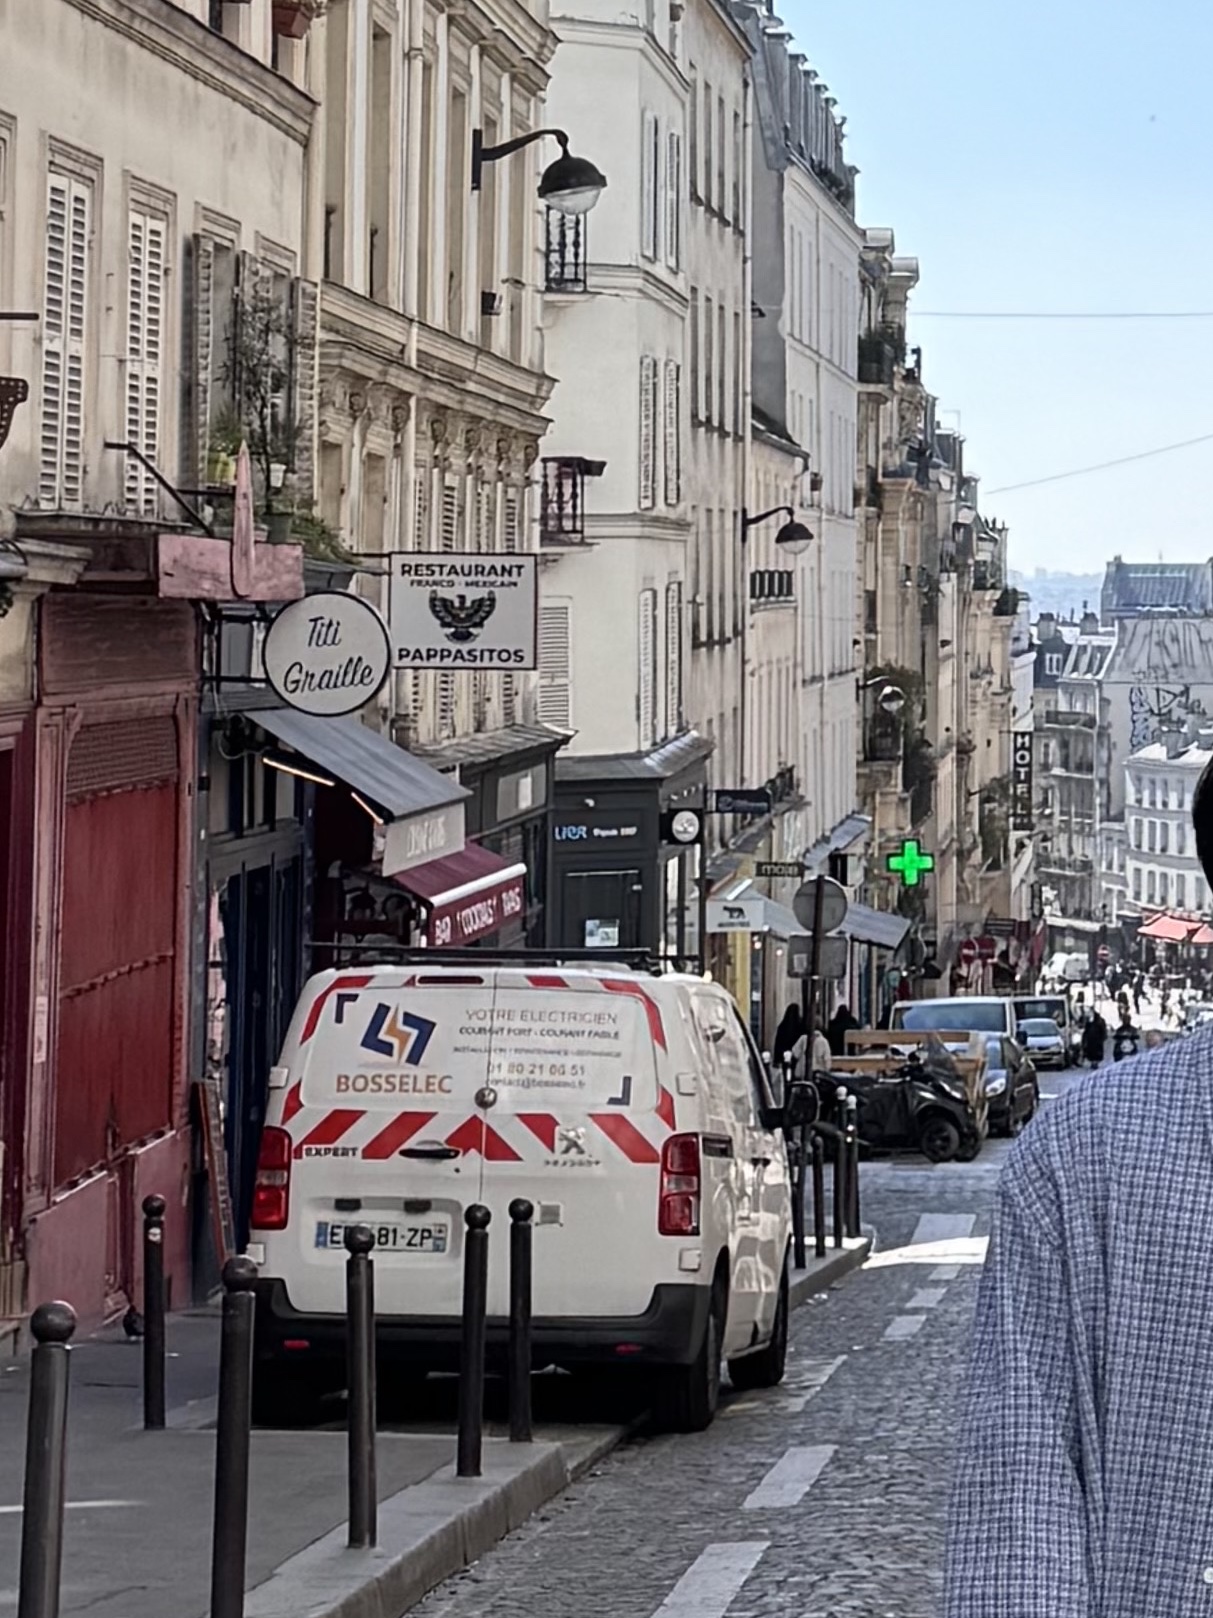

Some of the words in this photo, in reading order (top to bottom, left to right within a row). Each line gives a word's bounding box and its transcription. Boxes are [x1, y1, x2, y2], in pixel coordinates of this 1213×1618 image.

[401, 563, 525, 577] RESTAURANT
[410, 579, 455, 588] FRANCO
[308, 615, 342, 647] Titi
[398, 648, 525, 663] PAPPASITOS
[283, 656, 375, 694] Graille
[1015, 734, 1031, 815] HOTEL
[336, 1074, 453, 1094] BOSSELEC
[305, 1146, 359, 1157] EXPERT
